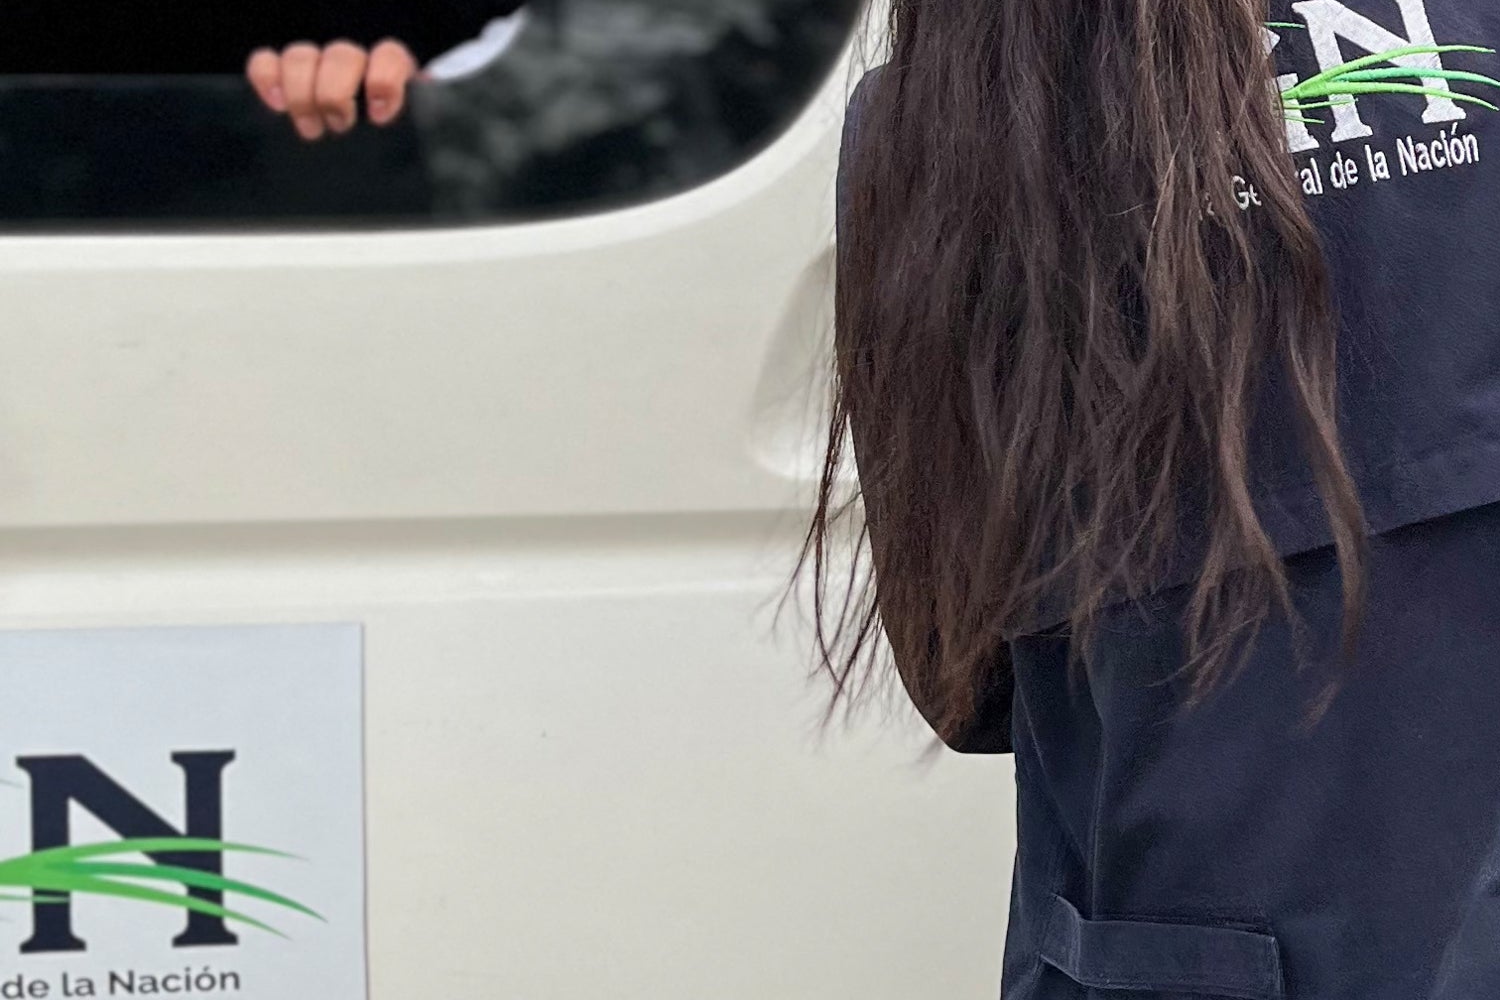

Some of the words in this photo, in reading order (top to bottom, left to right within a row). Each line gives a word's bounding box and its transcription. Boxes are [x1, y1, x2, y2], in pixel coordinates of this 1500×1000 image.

[1330, 151, 1358, 190] de
[1364, 144, 1390, 183] la
[1397, 121, 1479, 176] Nación
[1, 974, 50, 1000] de
[62, 972, 95, 997] la
[109, 966, 240, 995] Nación
